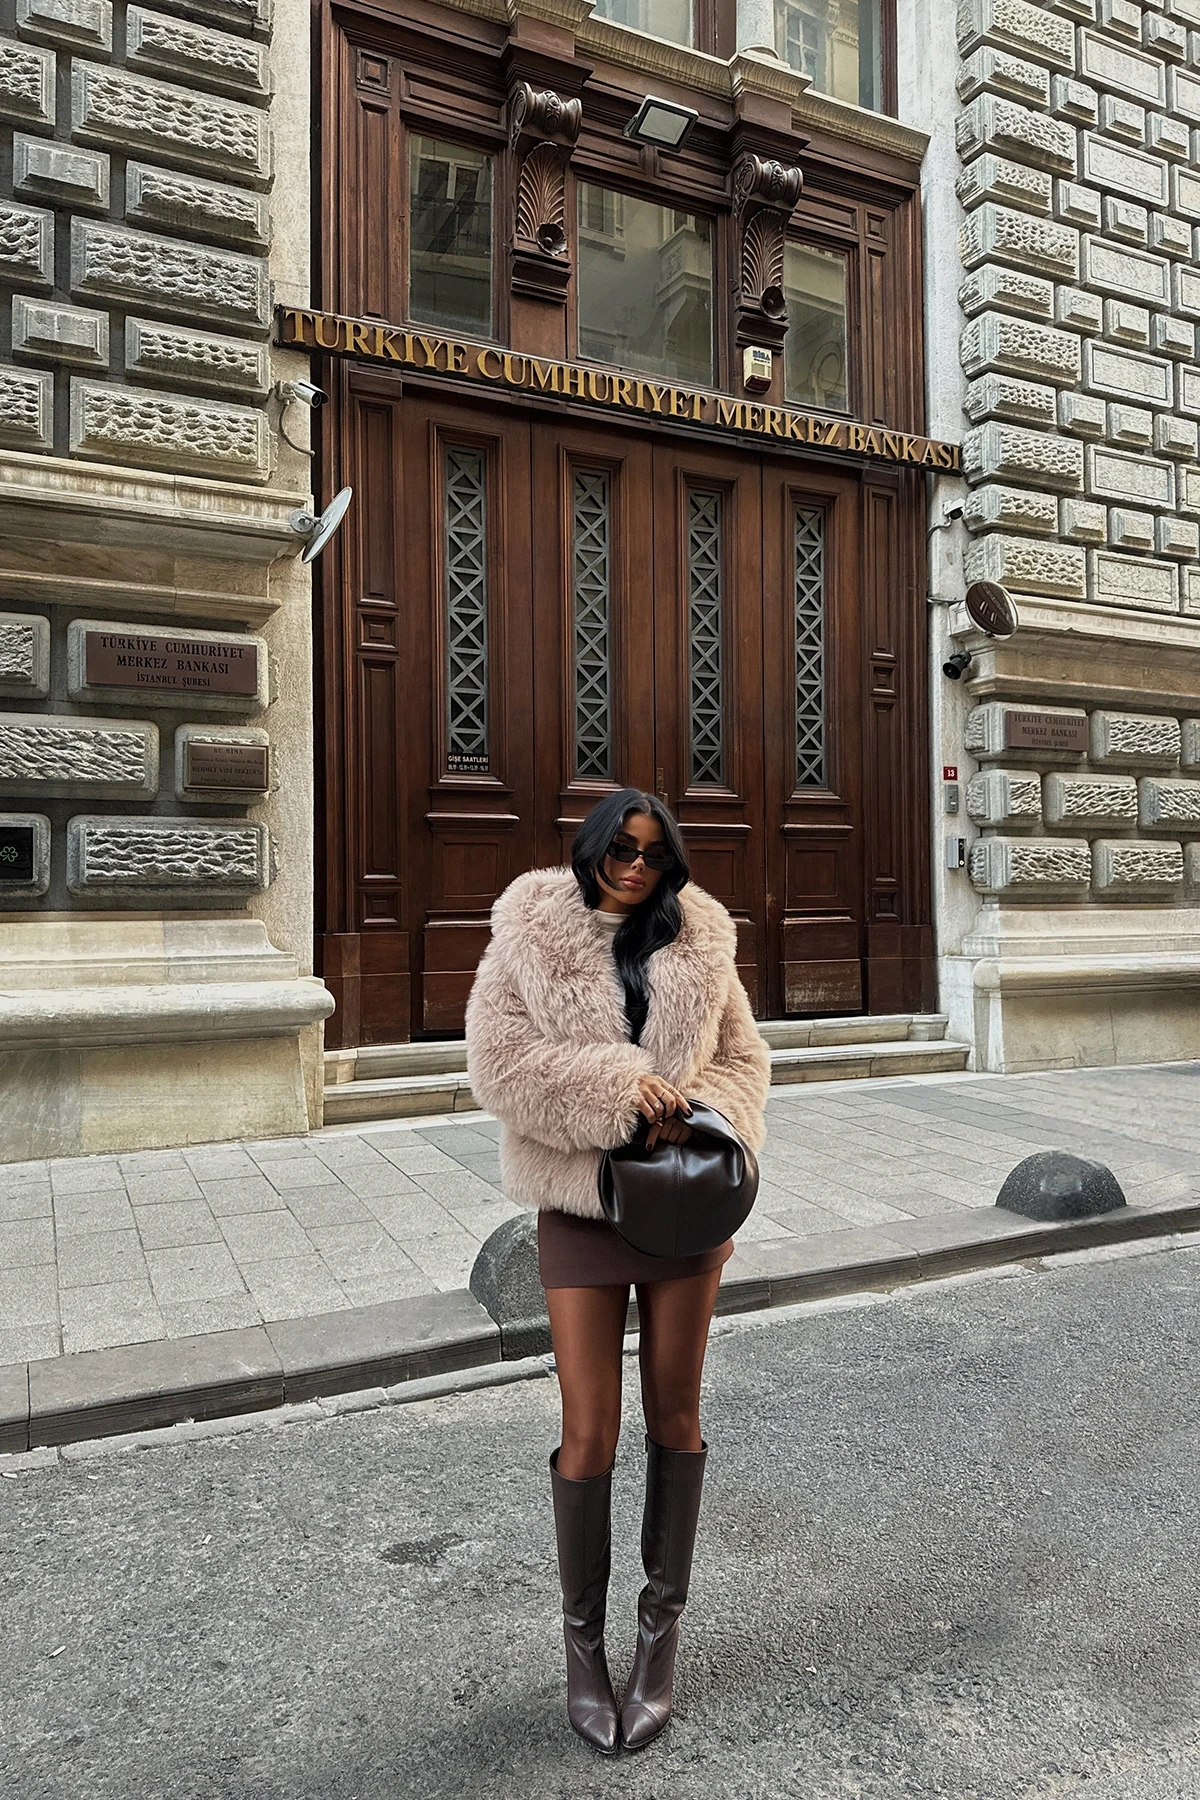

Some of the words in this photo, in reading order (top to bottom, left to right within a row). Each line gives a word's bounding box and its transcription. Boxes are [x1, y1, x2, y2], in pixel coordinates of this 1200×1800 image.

[715, 398, 842, 448] MERKEZ
[848, 424, 960, 470] BANKASI
[100, 636, 158, 652] TÜRKİYE
[165, 641, 245, 659] CUMHURİYET
[116, 655, 168, 669] MERKEZ
[177, 659, 229, 674] BANKASI
[136, 673, 178, 684] İSTANBUL
[181, 676, 211, 688] ŞUBESİ
[1021, 726, 1048, 736] MERKEZ
[1051, 728, 1078, 738] BANKASI
[448, 755, 461, 763] GİŞE
[947, 769, 955, 777] 13
